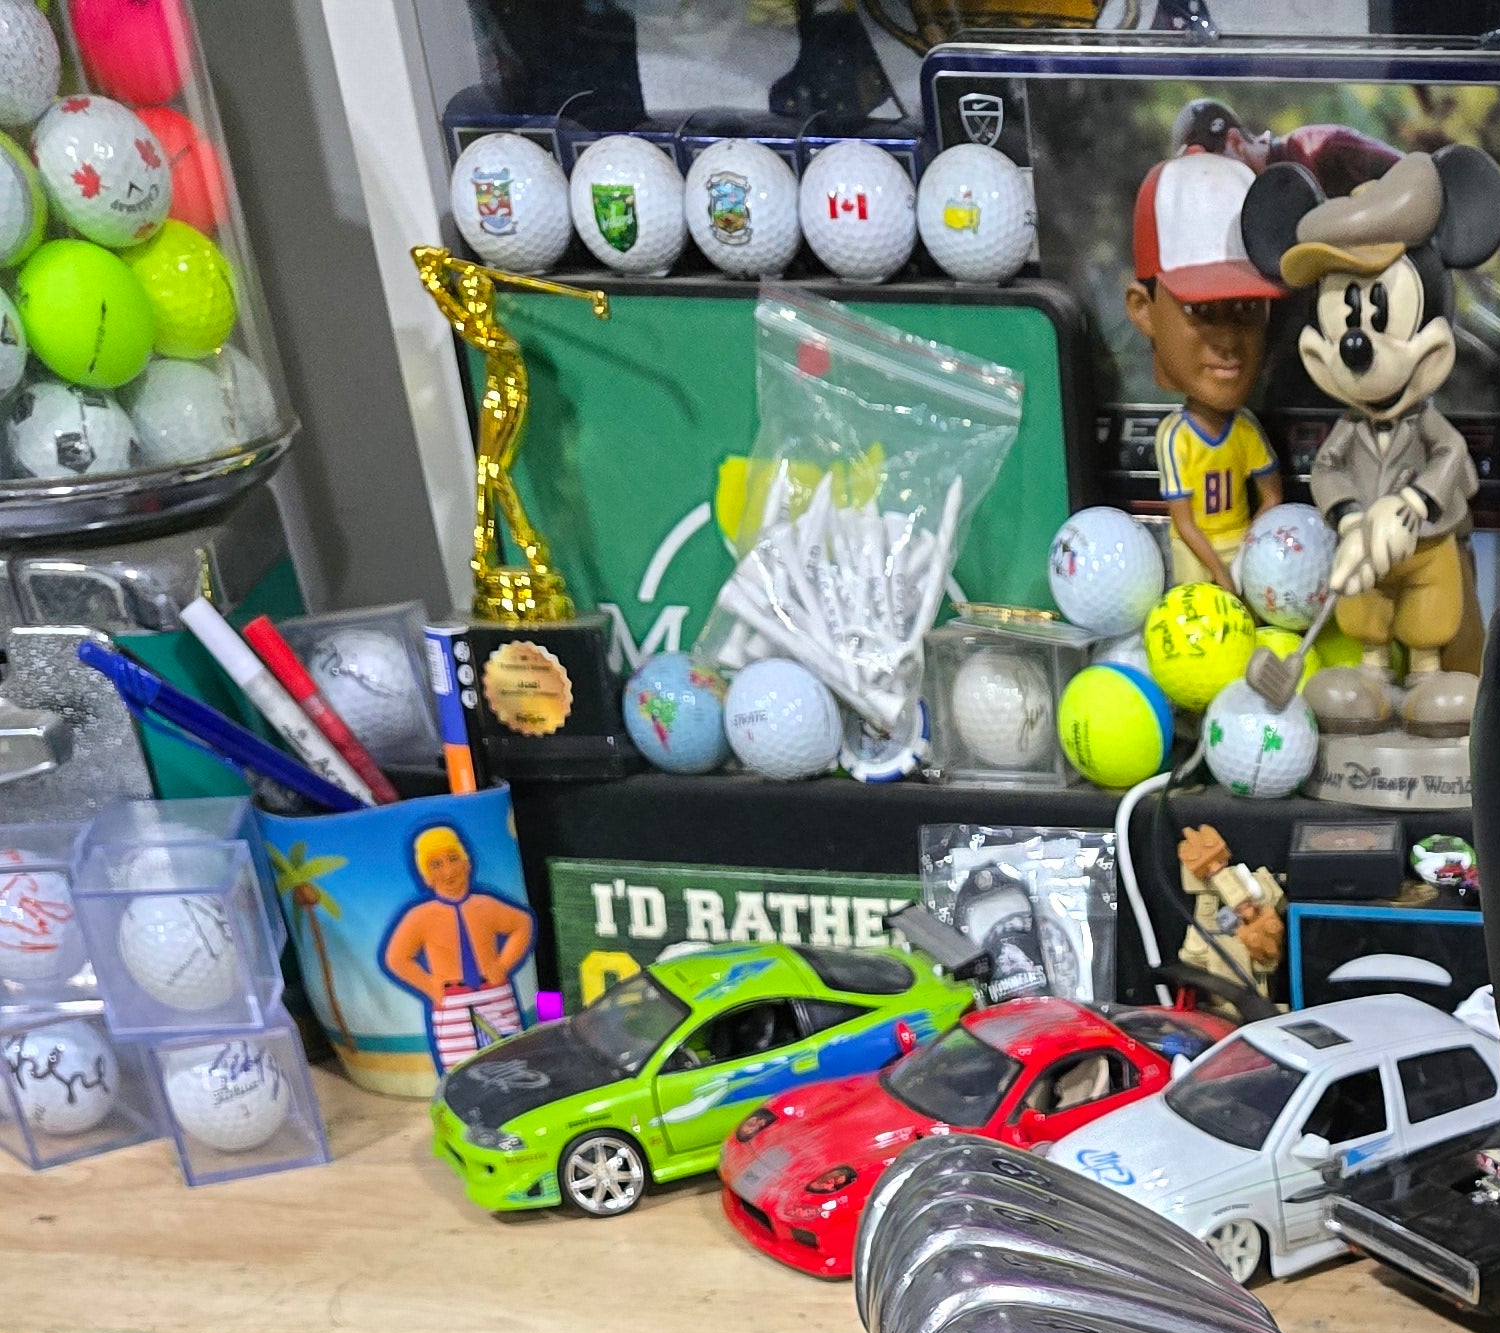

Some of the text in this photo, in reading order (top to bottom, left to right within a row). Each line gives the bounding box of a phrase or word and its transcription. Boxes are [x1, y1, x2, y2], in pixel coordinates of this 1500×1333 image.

[1204, 470, 1234, 516] 81
[1344, 761, 1419, 800] Disney
[591, 879, 669, 940] I'D
